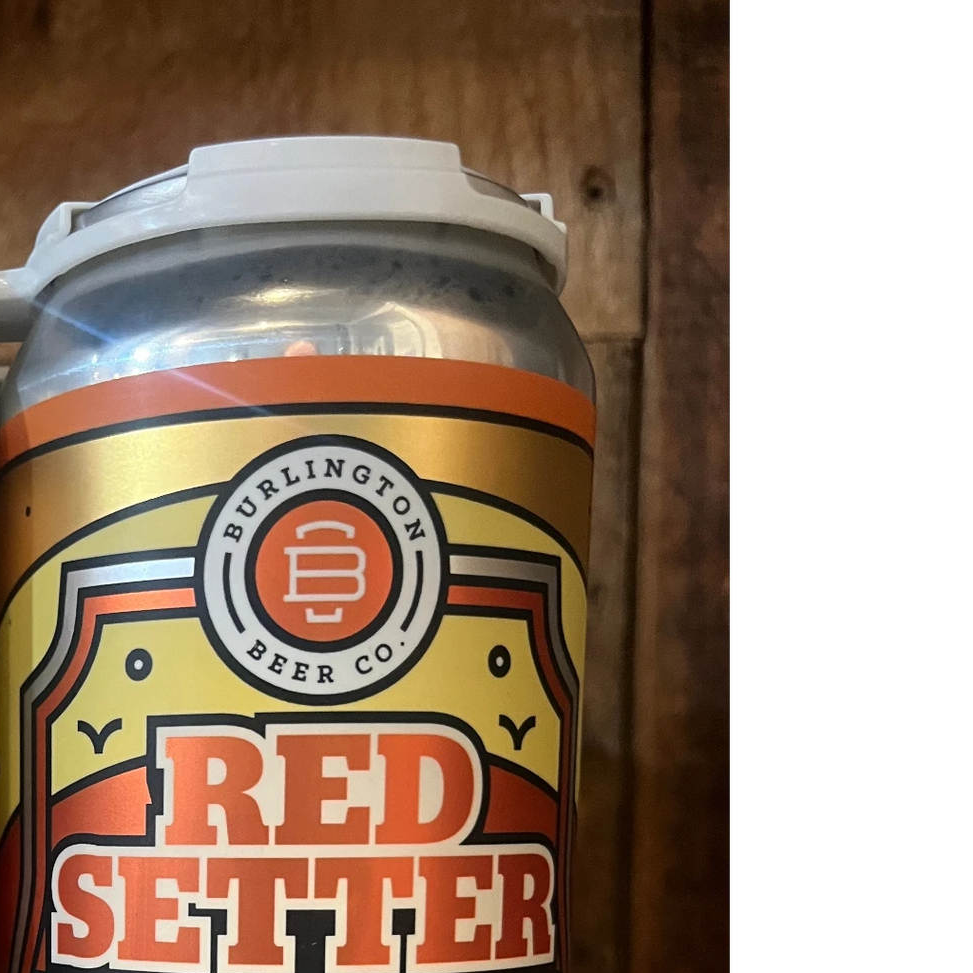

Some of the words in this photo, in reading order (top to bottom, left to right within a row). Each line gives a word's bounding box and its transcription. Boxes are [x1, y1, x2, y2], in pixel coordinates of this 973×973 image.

[223, 458, 427, 543] BURLINGTON
[246, 638, 335, 684] BEER
[355, 638, 407, 677] CO.
[164, 733, 476, 847] RED
[57, 854, 554, 967] SETTER
